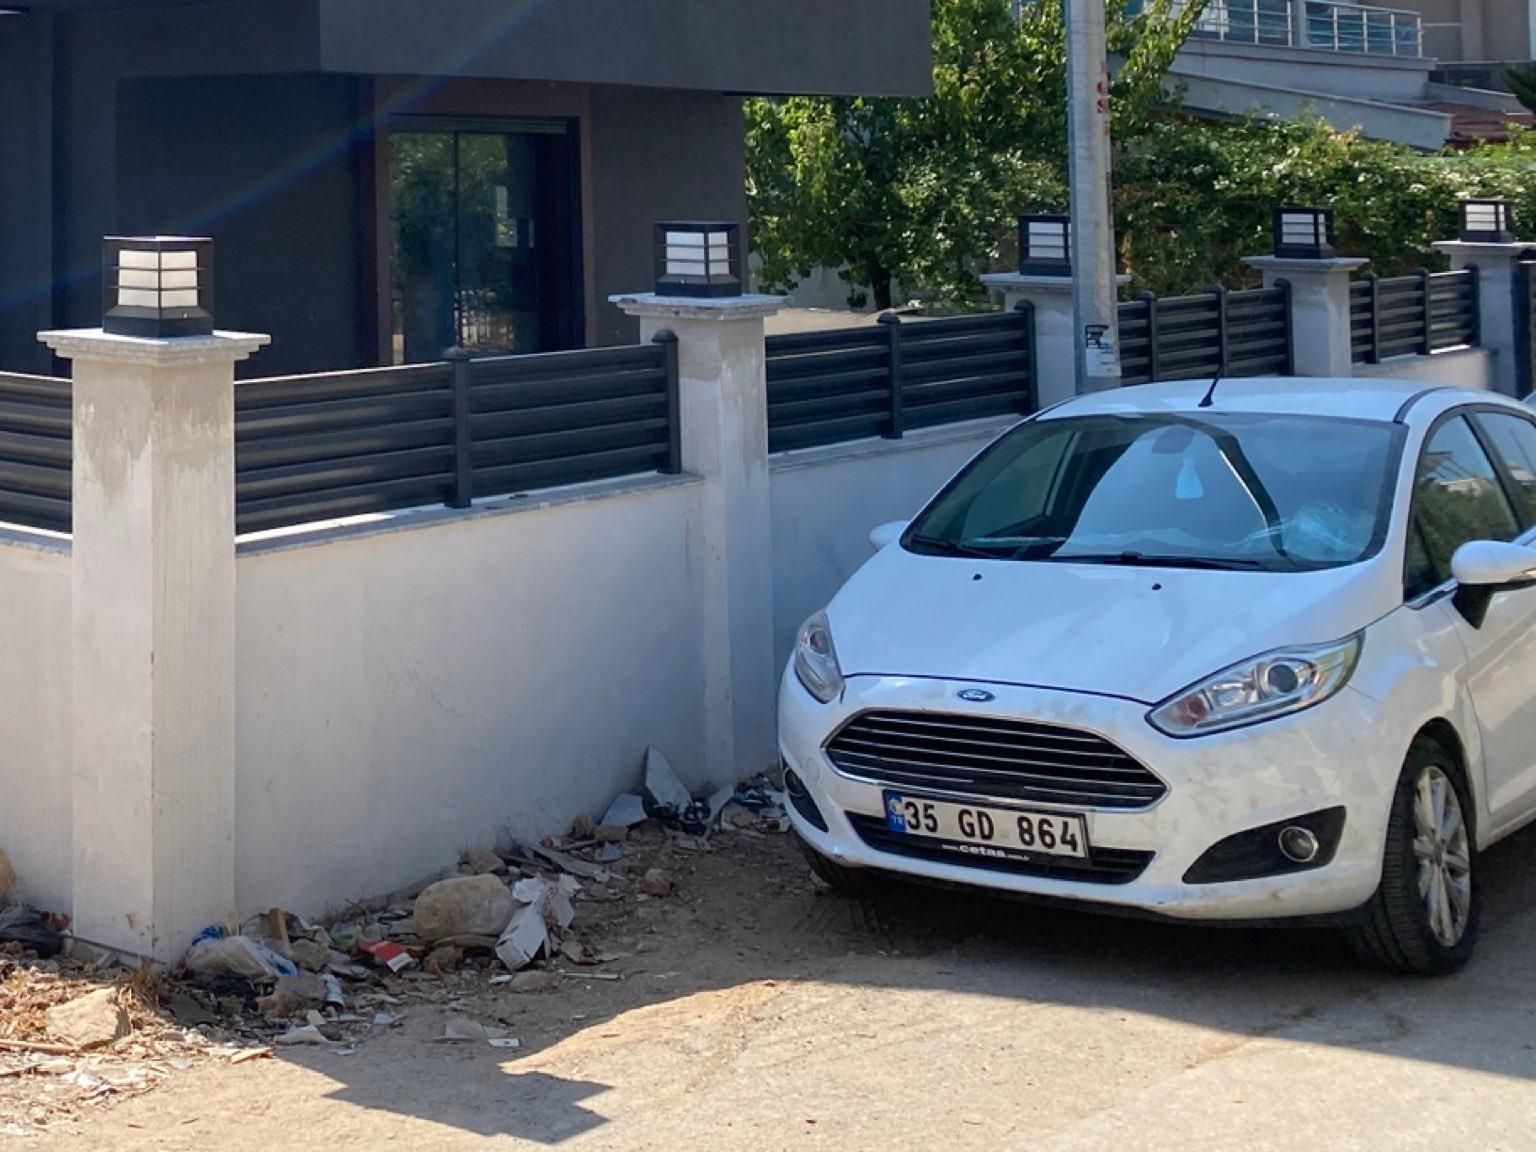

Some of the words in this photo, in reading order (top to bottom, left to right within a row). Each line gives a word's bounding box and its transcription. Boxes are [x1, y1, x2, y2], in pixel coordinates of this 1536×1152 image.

[904, 801, 939, 833] 35
[957, 808, 995, 841] GD
[1017, 816, 1079, 853] 864
